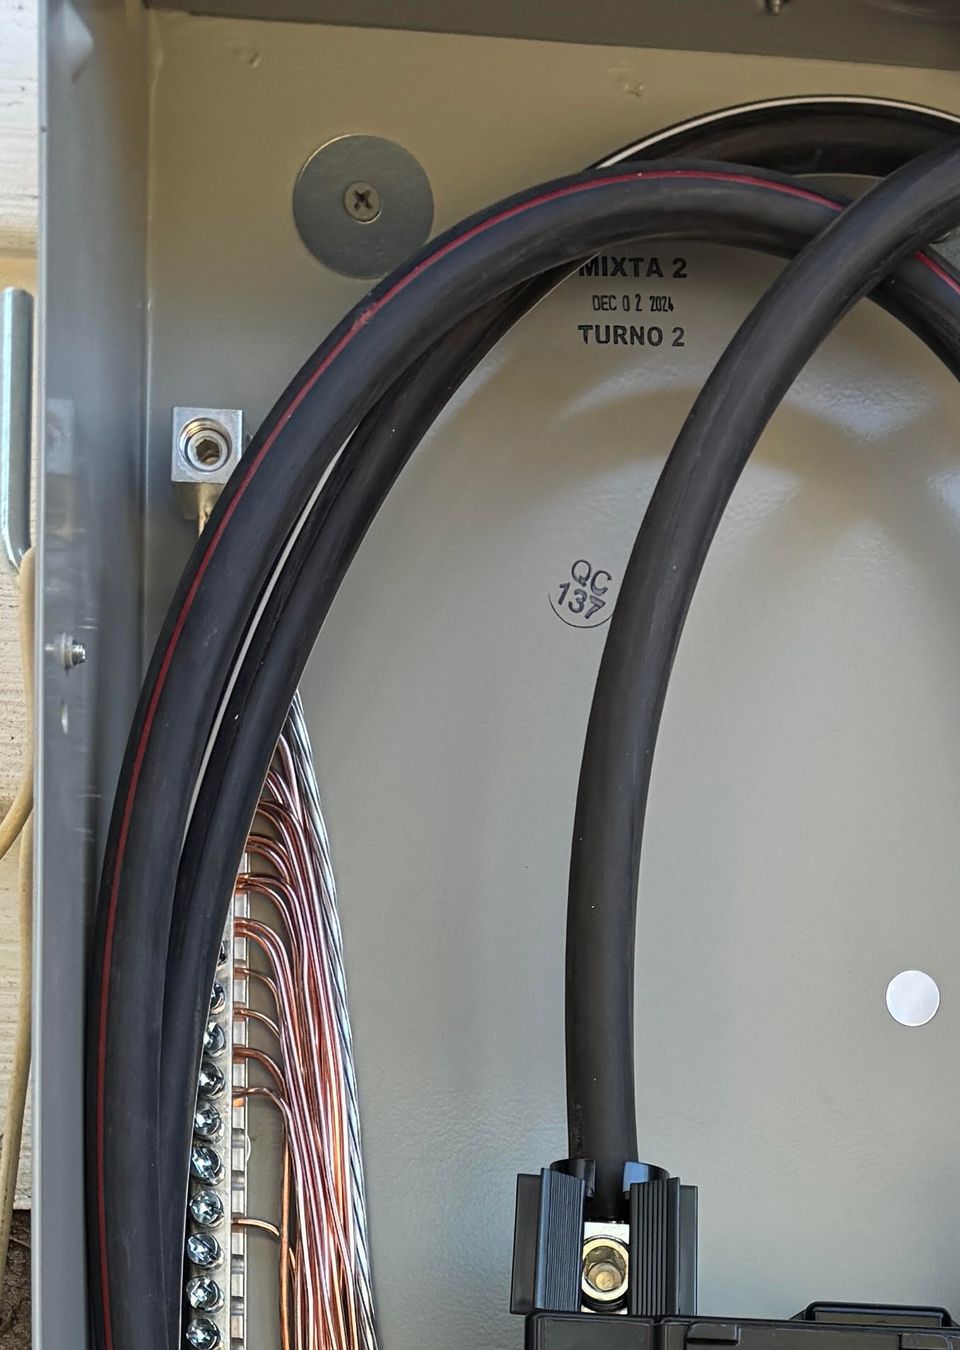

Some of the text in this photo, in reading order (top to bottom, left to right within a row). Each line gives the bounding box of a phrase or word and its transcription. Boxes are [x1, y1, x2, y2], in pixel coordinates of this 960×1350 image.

[578, 255, 688, 279] MIXTA 2
[592, 294, 617, 312] DEC
[578, 324, 685, 347] TURNO 2
[571, 559, 613, 597] QC
[558, 582, 606, 620] 137
